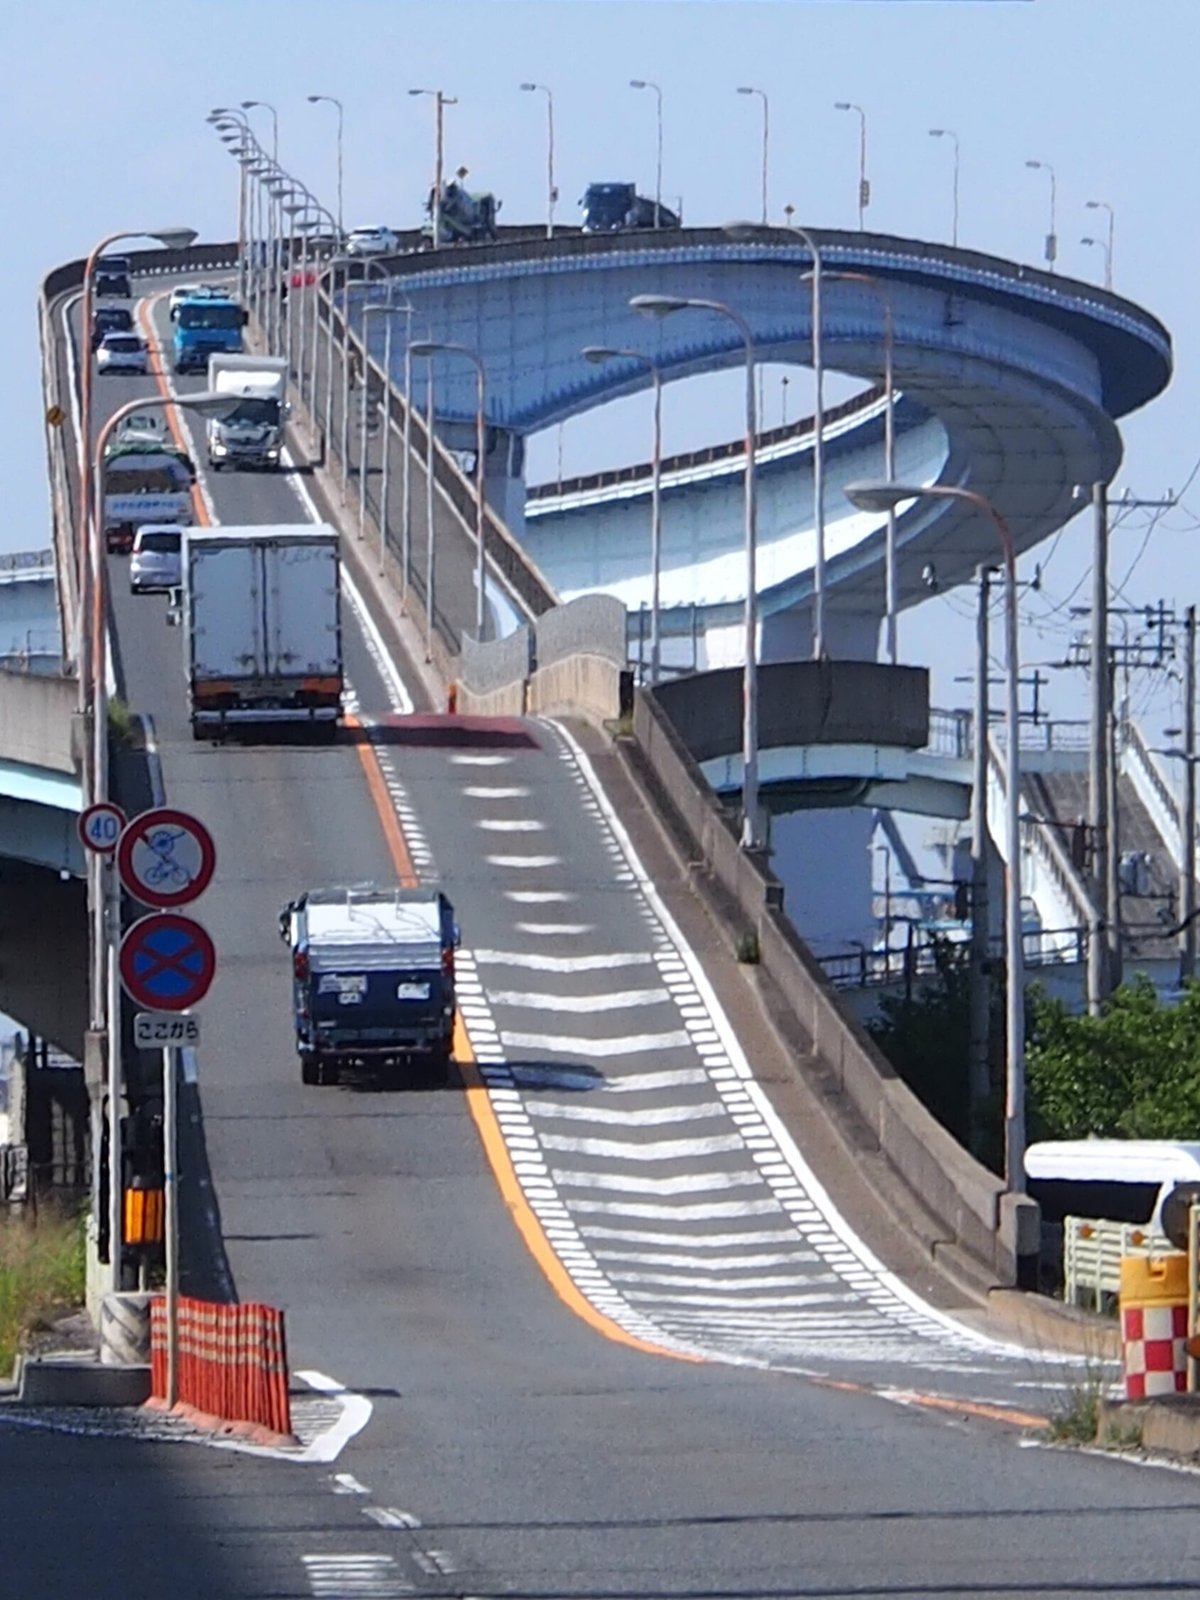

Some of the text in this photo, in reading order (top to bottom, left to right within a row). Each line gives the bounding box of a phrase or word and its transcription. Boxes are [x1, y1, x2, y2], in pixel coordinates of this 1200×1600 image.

[91, 817, 118, 840] 40
[138, 1021, 199, 1040] ここから
